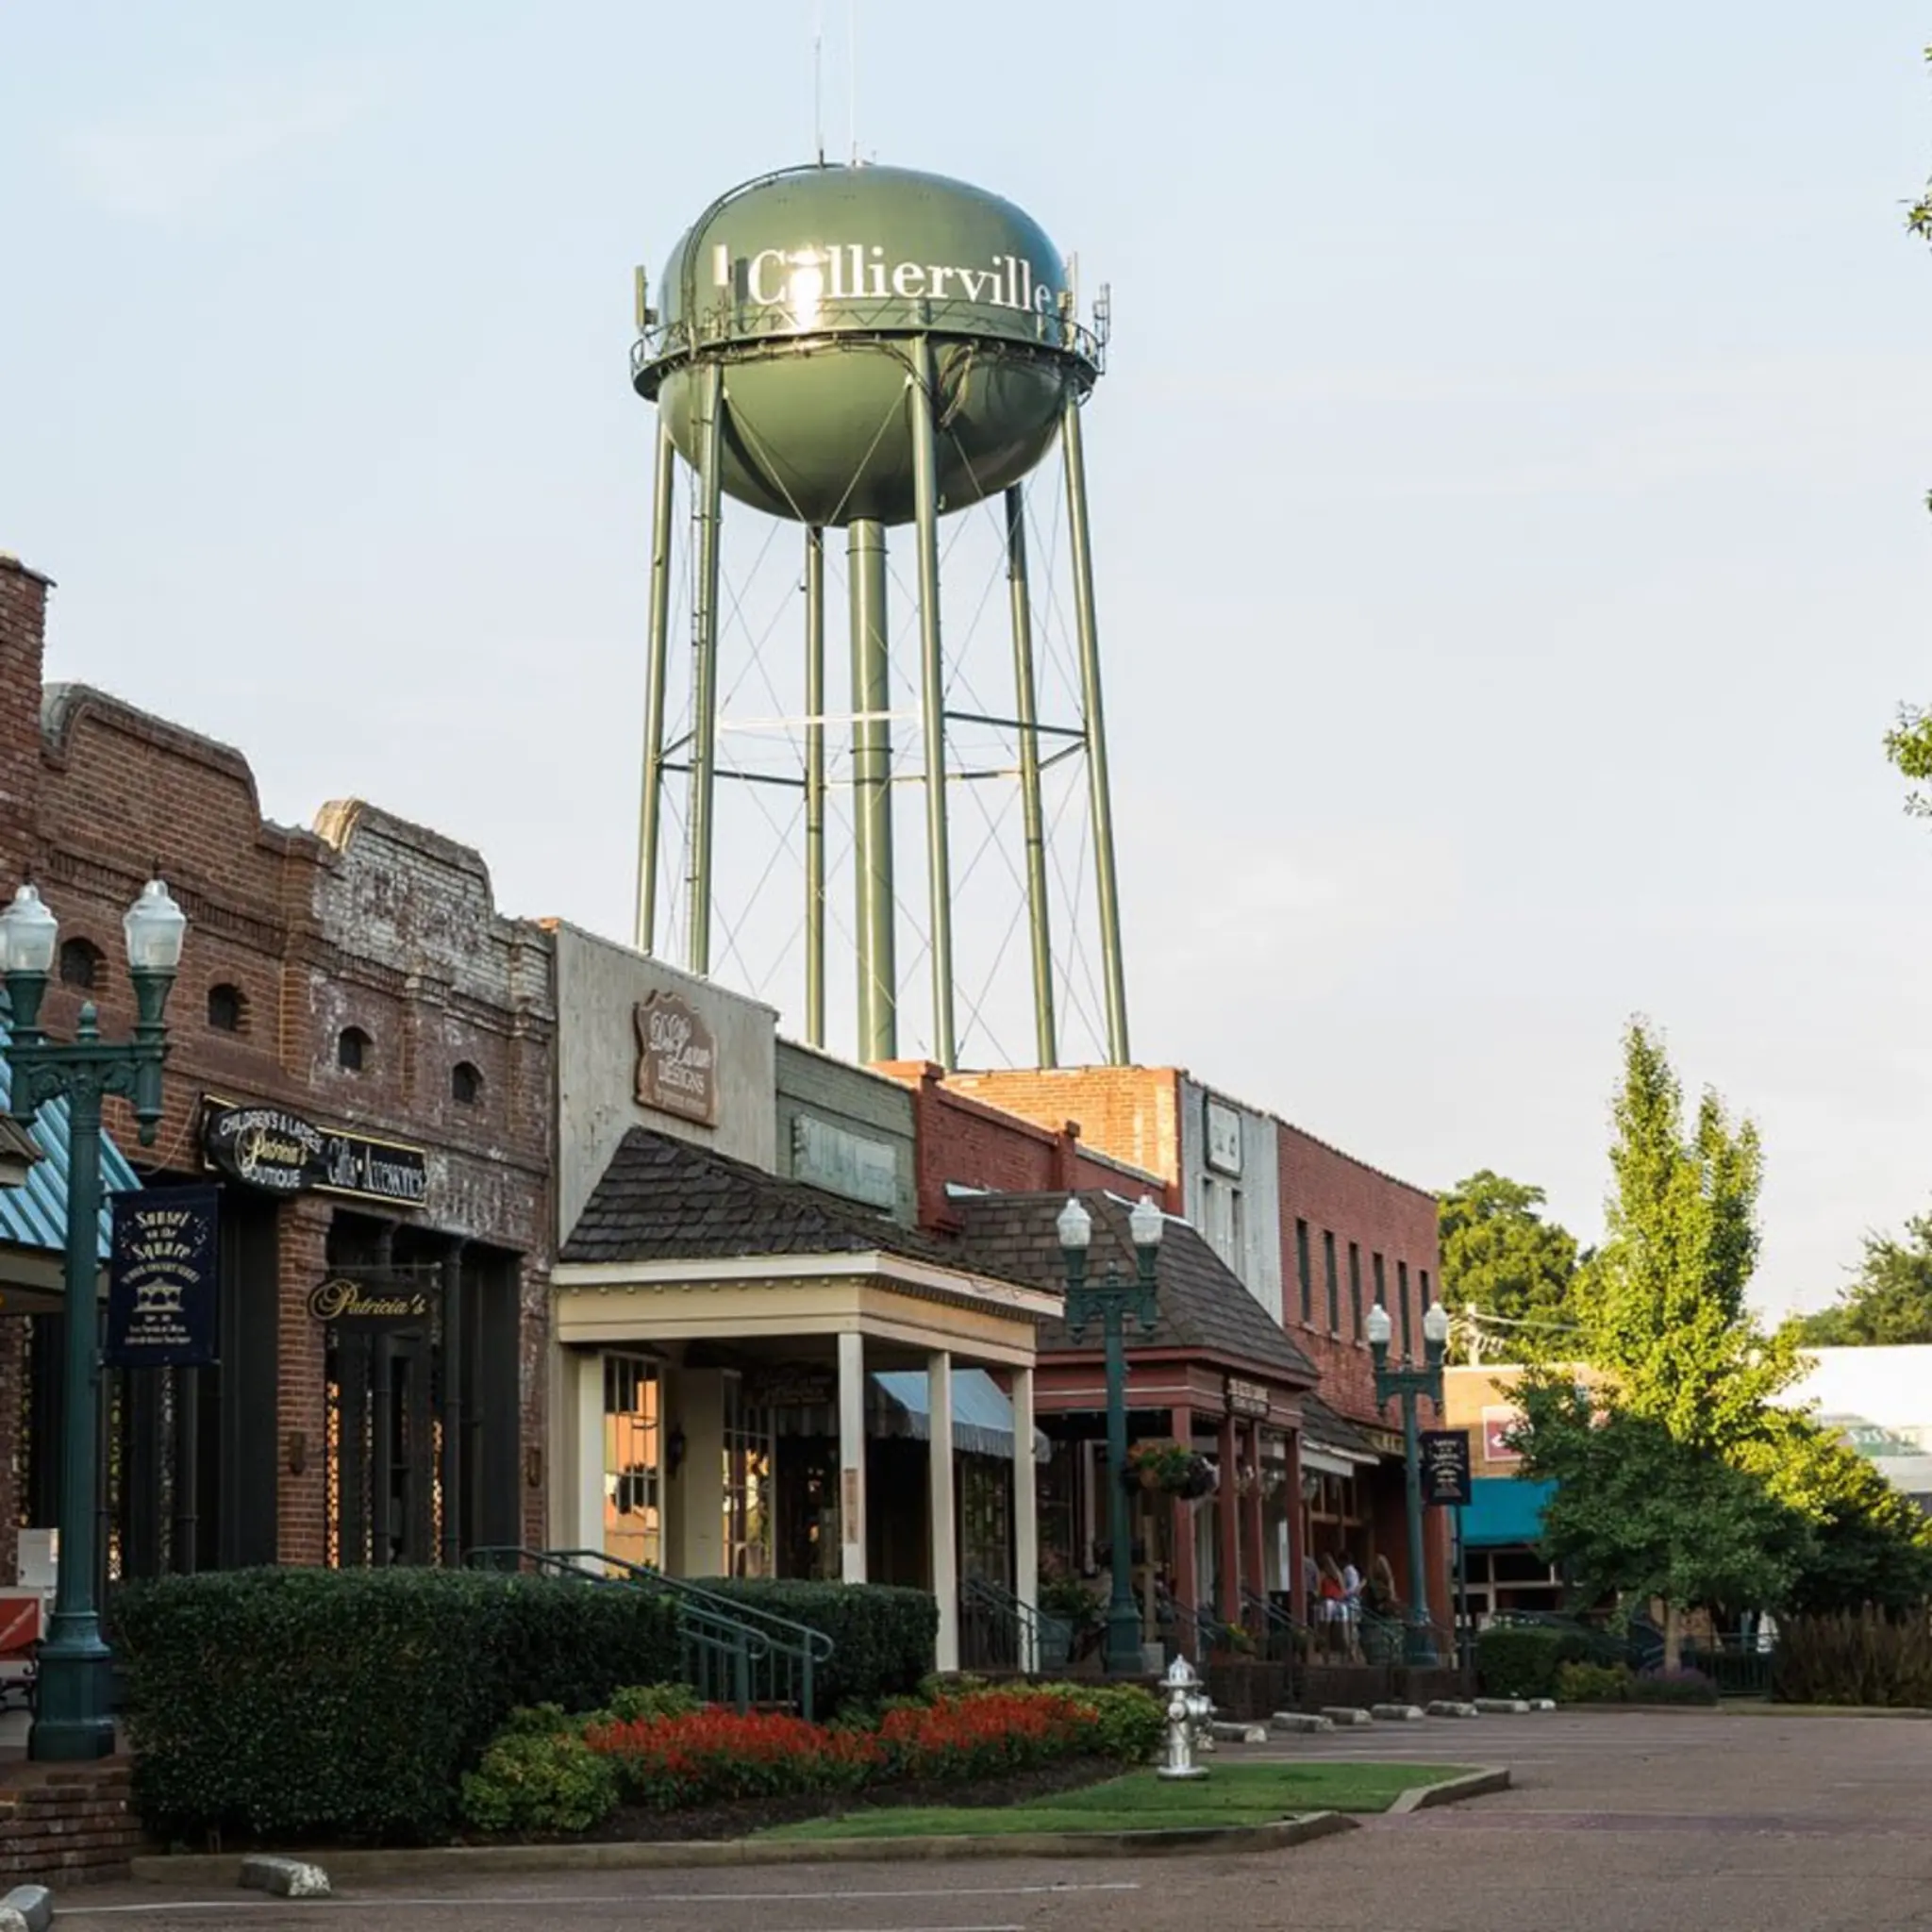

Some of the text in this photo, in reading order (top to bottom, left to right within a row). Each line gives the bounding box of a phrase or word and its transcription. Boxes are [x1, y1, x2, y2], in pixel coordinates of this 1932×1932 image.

[134, 1210, 192, 1229] Sunset
[130, 1240, 192, 1260] Square
[310, 1278, 426, 1320] Patricia's
